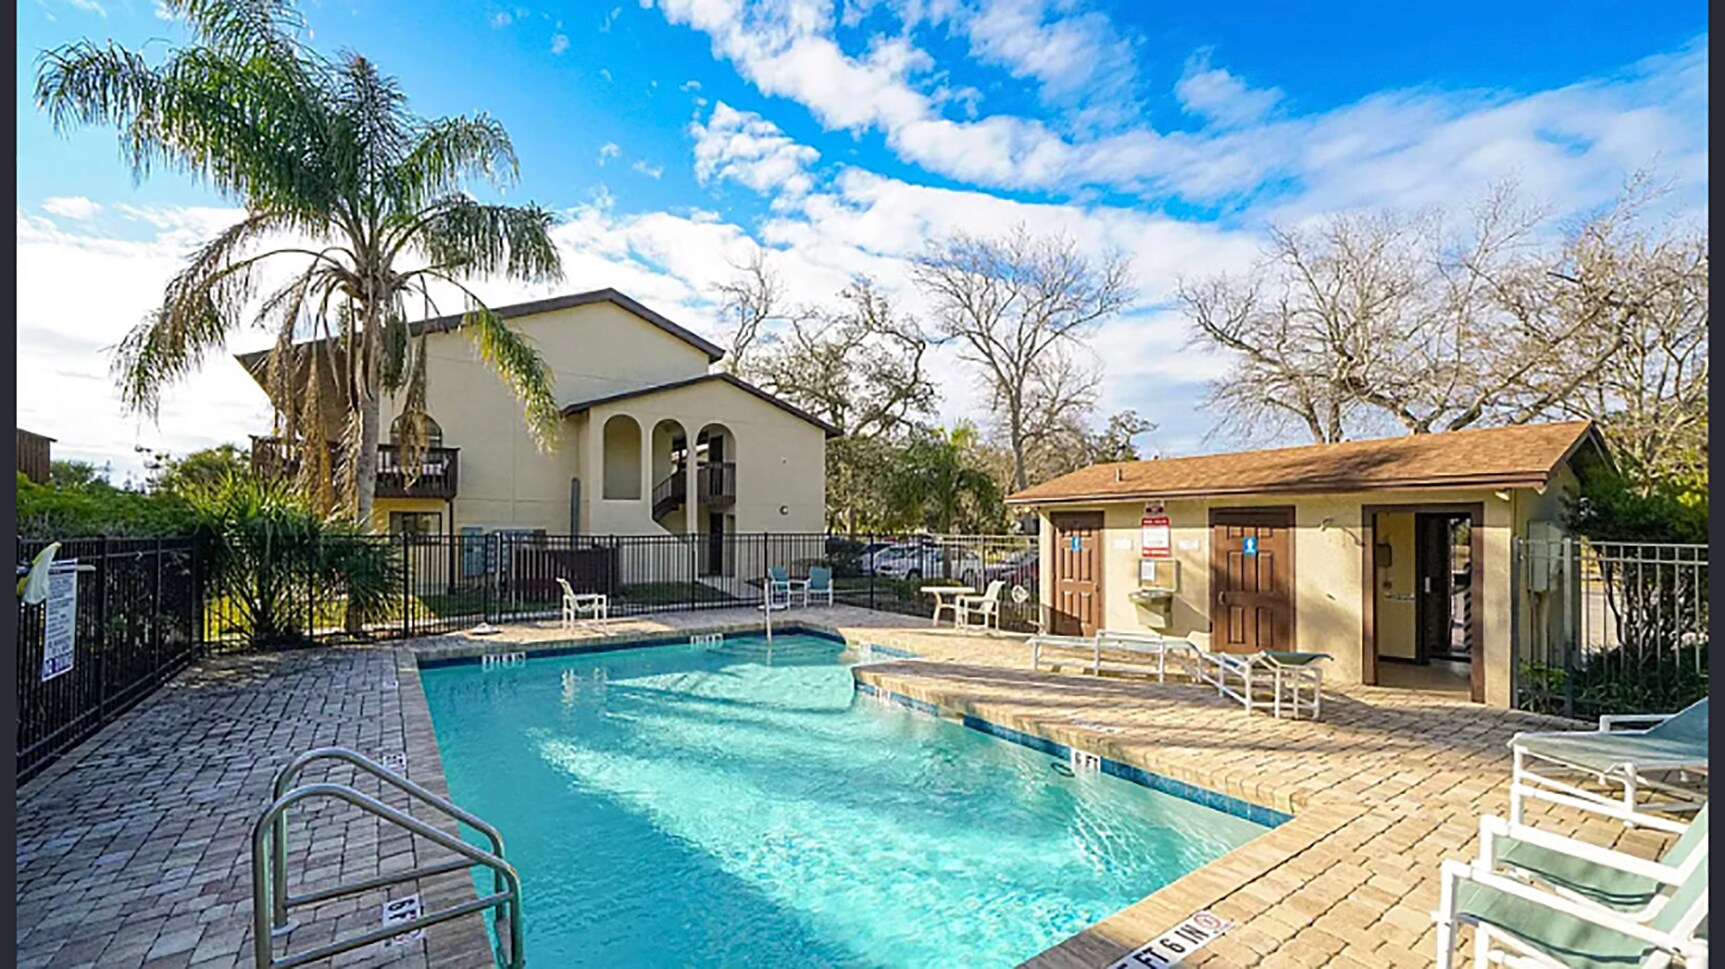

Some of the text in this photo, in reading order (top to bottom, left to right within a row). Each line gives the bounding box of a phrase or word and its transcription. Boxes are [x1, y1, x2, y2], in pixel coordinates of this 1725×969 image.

[1085, 754, 1099, 772] FT
[1132, 946, 1170, 969] FT
[1159, 938, 1187, 953] 6
[1174, 923, 1210, 945] IN
